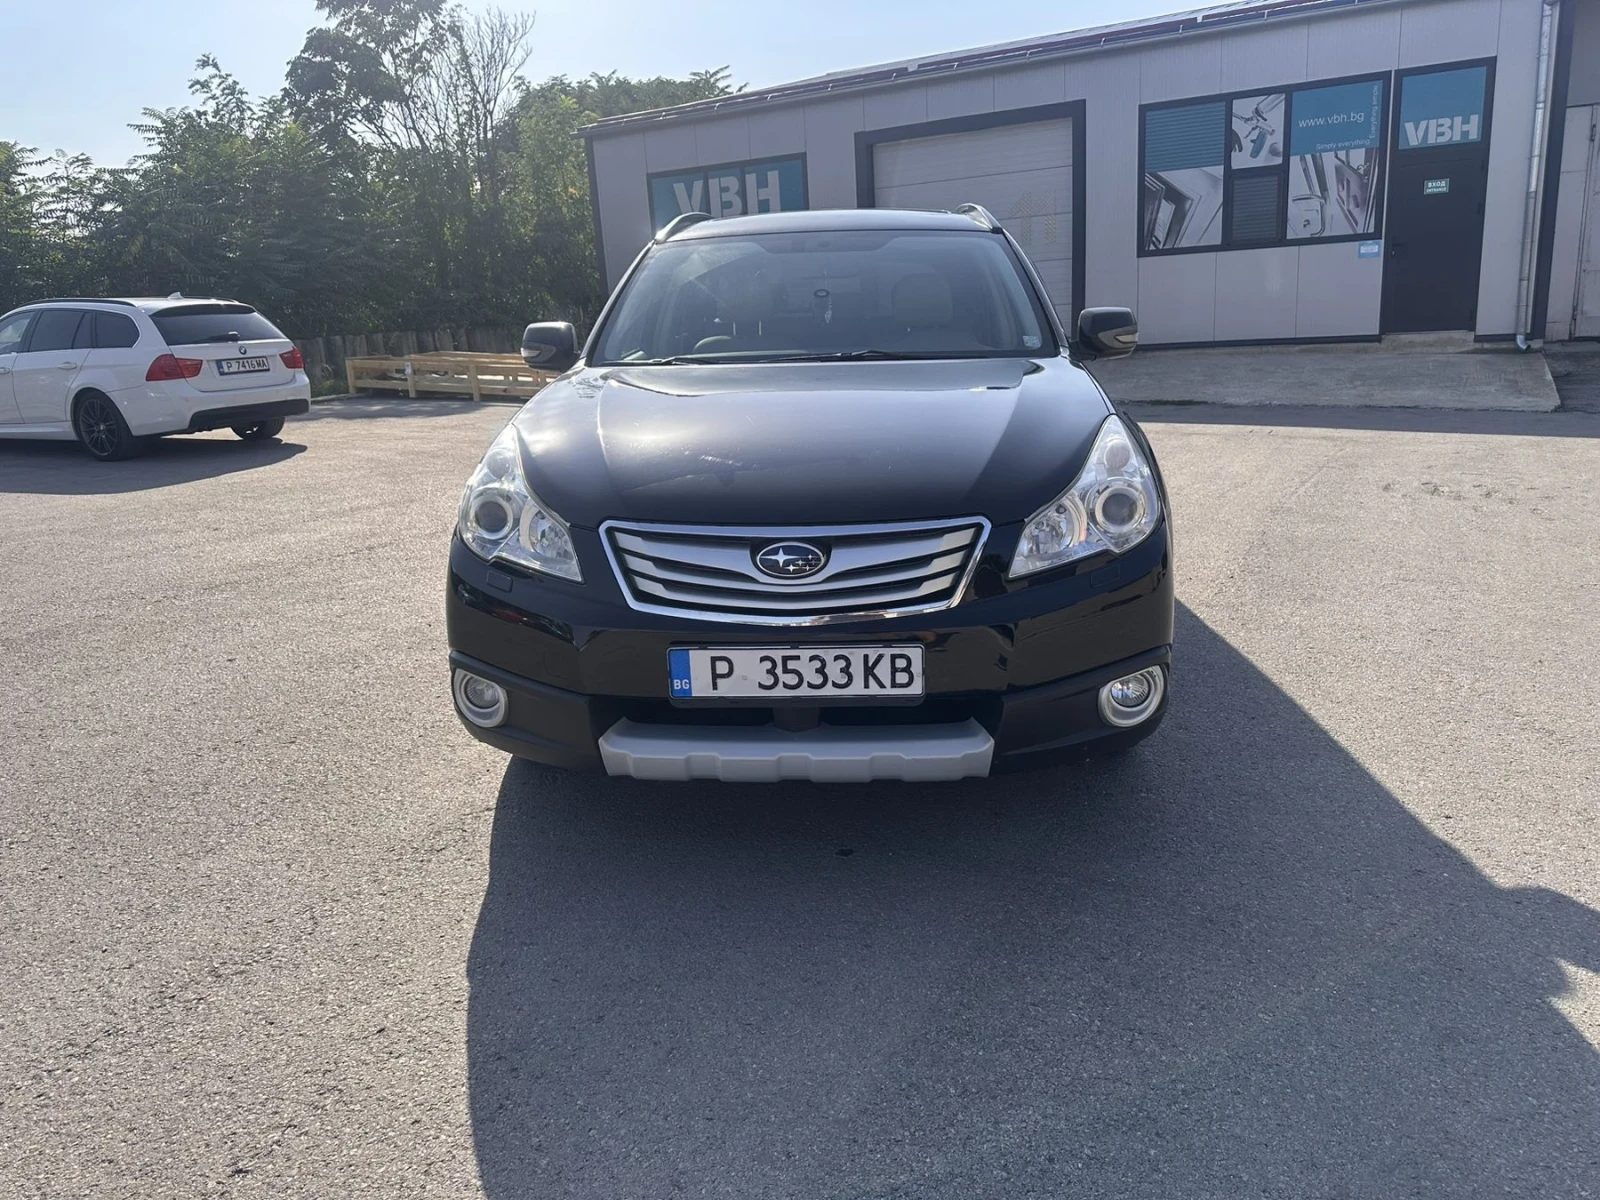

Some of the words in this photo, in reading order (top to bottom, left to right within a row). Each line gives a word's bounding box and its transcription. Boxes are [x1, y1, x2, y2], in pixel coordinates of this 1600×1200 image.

[1298, 112, 1364, 127] www.vbh.bg
[1404, 114, 1479, 146] VBH
[673, 170, 781, 217] VBH
[226, 361, 233, 371] P
[673, 679, 690, 690] BG
[710, 656, 734, 691] P
